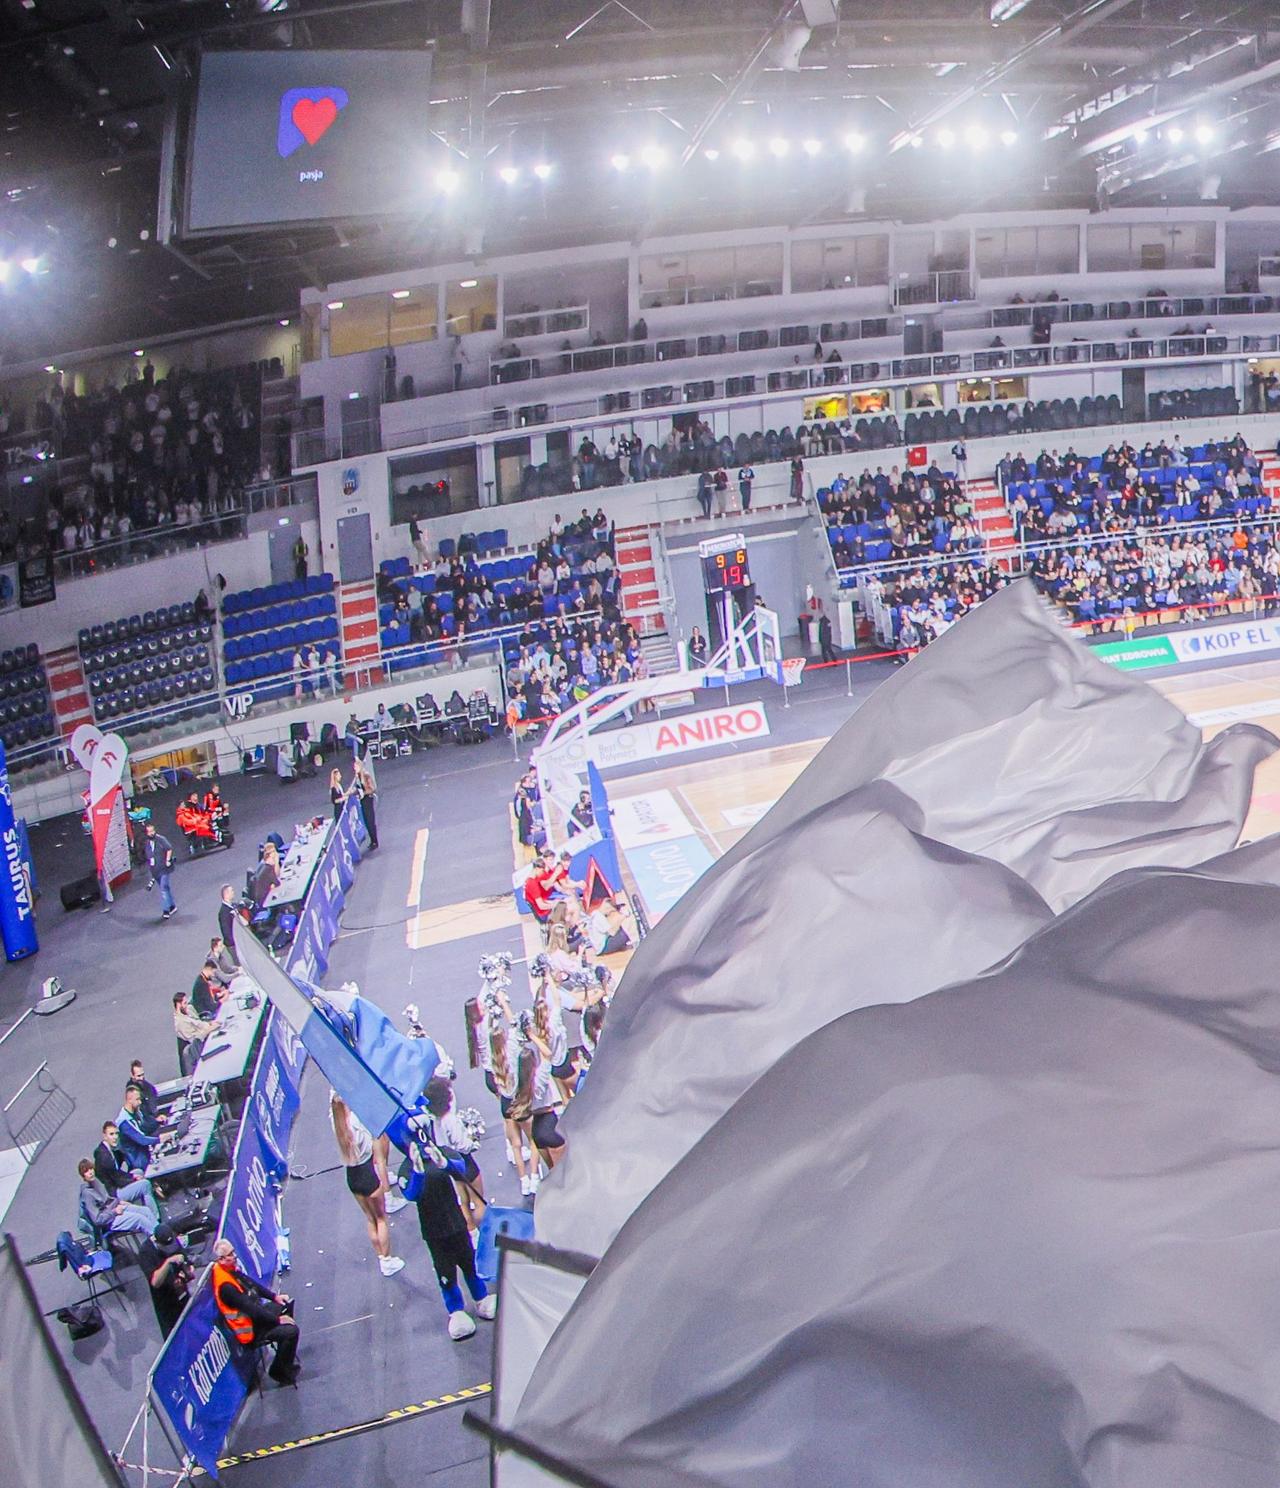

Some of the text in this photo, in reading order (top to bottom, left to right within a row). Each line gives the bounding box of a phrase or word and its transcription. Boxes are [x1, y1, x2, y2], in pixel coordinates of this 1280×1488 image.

[299, 169, 324, 182] pasja
[716, 550, 745, 569] 9 6
[723, 565, 742, 586] 19
[225, 693, 254, 717] VIP
[655, 708, 763, 752] ANIRO
[3, 827, 30, 921] TAURUS
